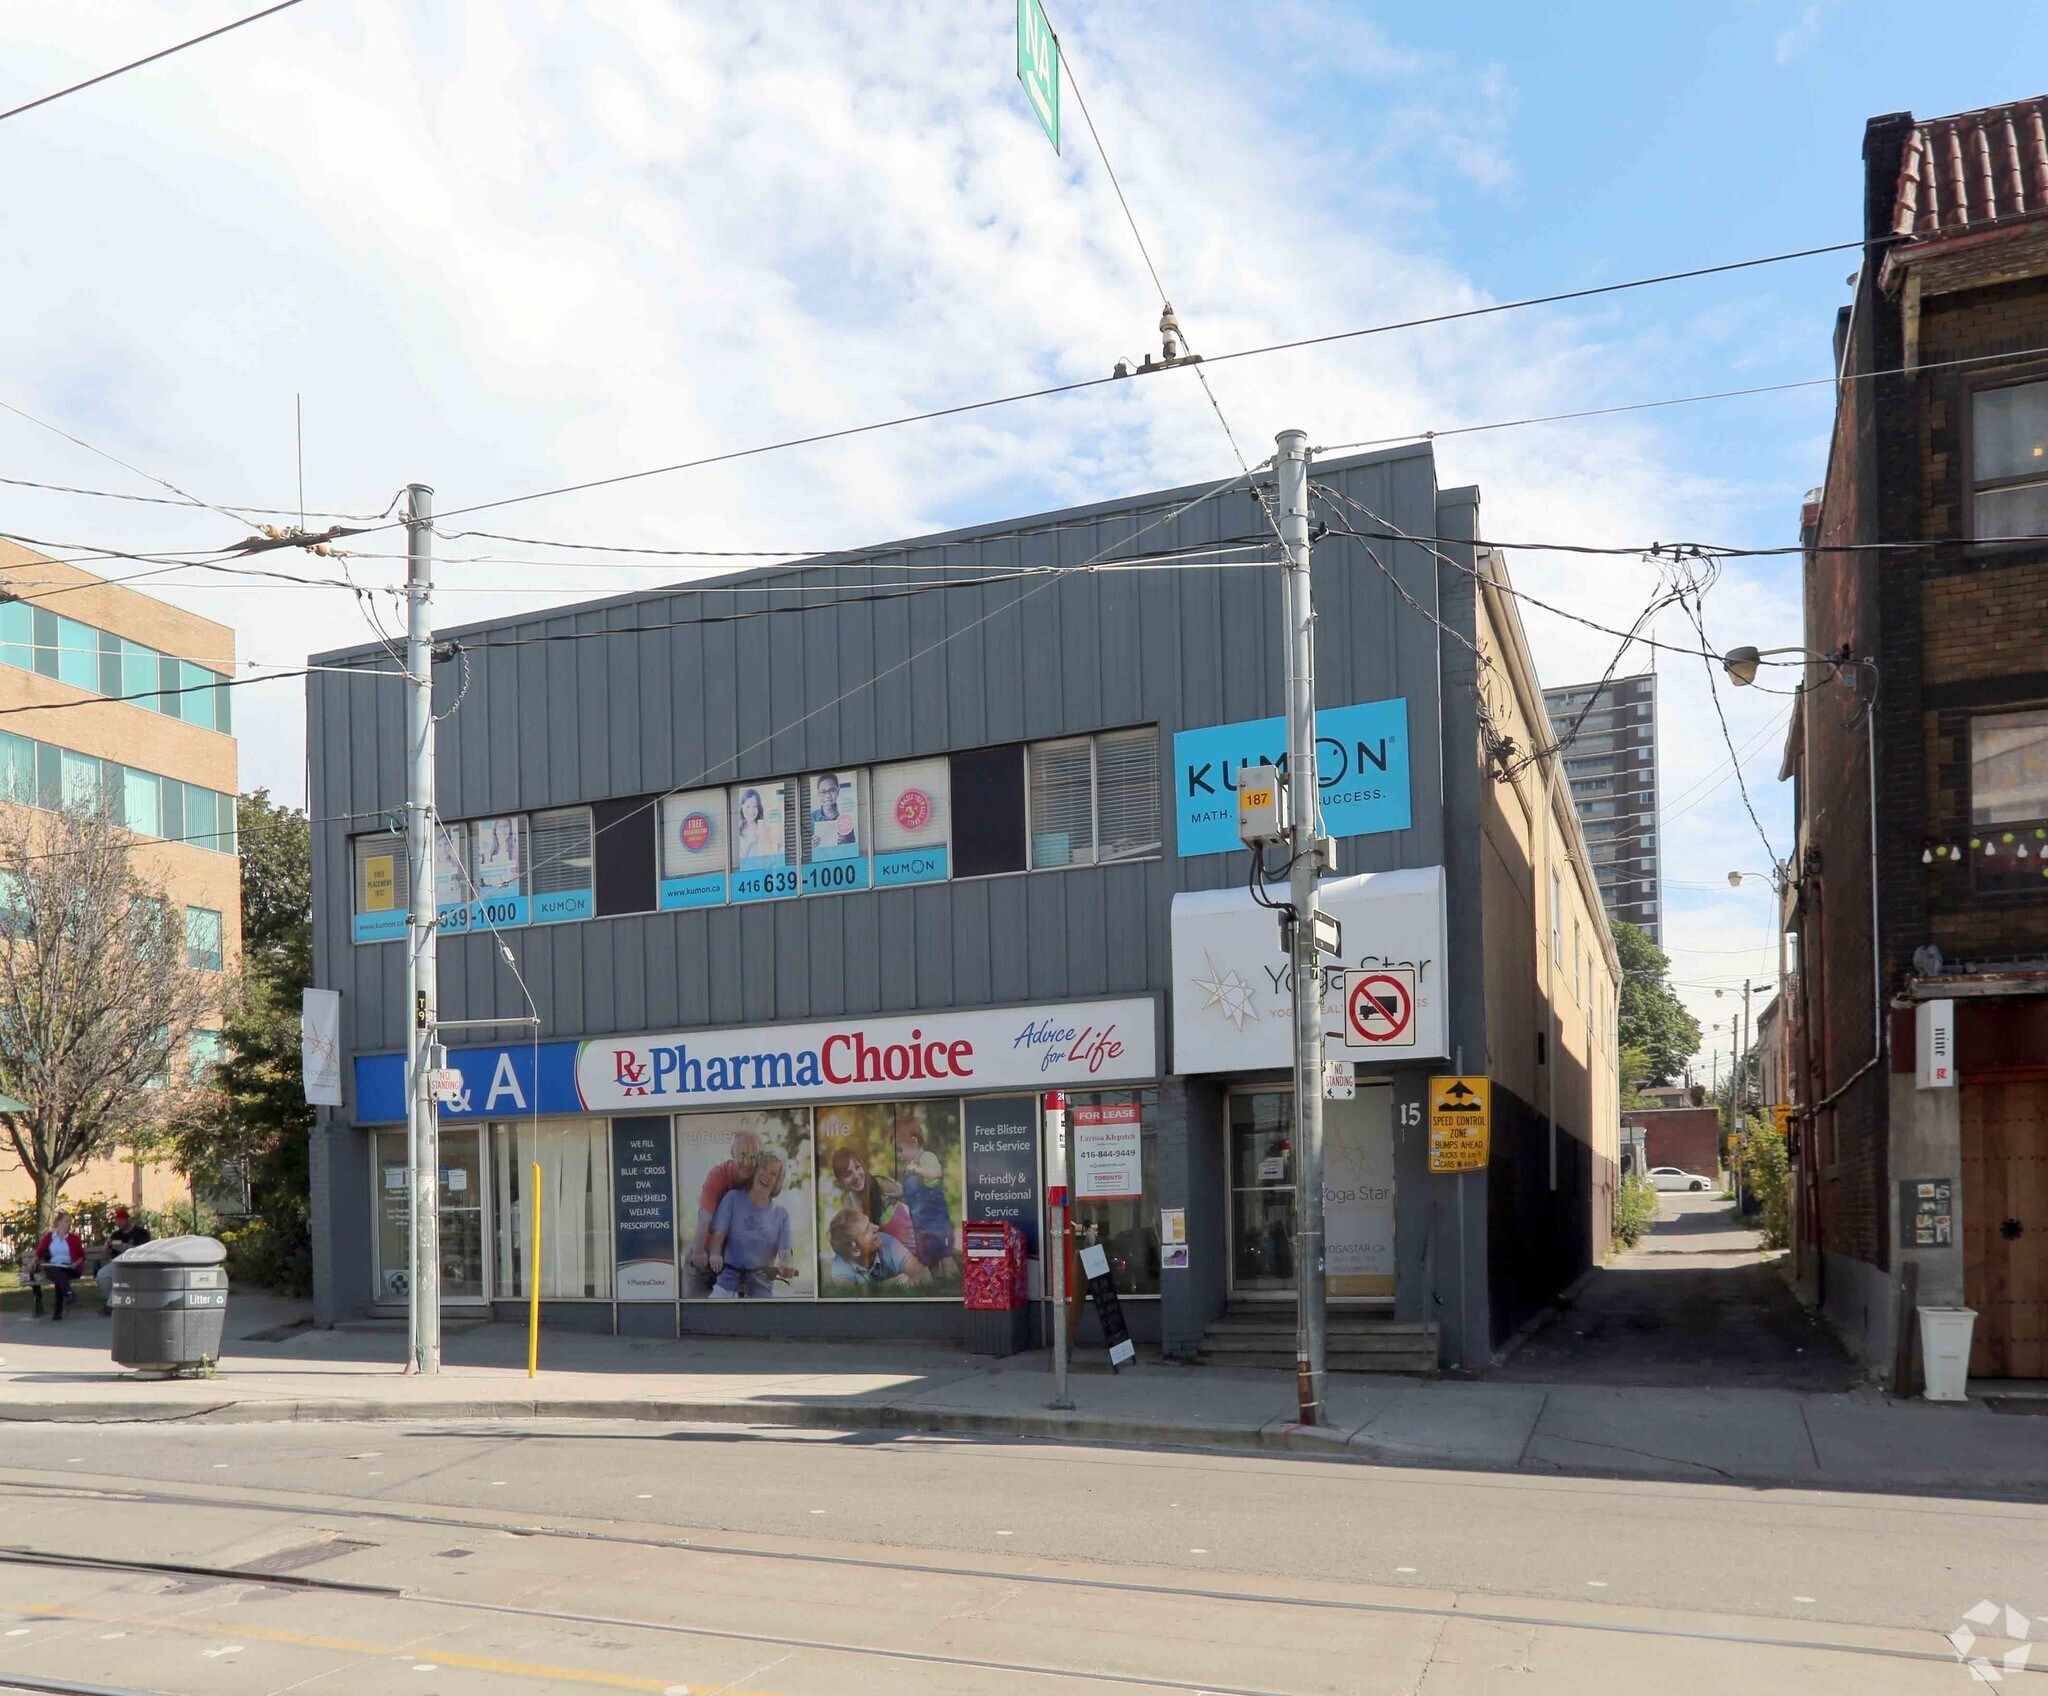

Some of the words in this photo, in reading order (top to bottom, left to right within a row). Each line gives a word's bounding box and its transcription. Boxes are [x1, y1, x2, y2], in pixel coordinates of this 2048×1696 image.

[1246, 793, 1268, 806] 187
[1318, 789, 1386, 806] UCCESS.
[1190, 810, 1233, 824] MATH.
[688, 818, 703, 829] FREE
[883, 859, 935, 875] KUMON
[374, 870, 385, 878] FREE
[738, 879, 761, 894] 416
[764, 865, 856, 893] 639-1000
[367, 880, 392, 888] PLACEMENT
[374, 889, 385, 897] TEST
[667, 884, 721, 898] www.kumon.ca
[541, 898, 585, 913] KUMON
[1013, 1018, 1076, 1049] Advice
[1041, 1045, 1066, 1072] for
[1067, 1024, 1125, 1073] Life
[648, 1028, 974, 1095] PharmaChoice
[1334, 1063, 1343, 1075] NO
[439, 1071, 451, 1080] NO
[1325, 1075, 1354, 1087] STANDING
[431, 1080, 459, 1090] STANDING
[485, 1053, 527, 1111] A
[1079, 1111, 1100, 1120] FOR
[1102, 1109, 1136, 1119] LEASE
[1400, 1102, 1421, 1126] 15
[1432, 1115, 1454, 1126] SPEED
[1456, 1115, 1486, 1126] CONTROL
[825, 1119, 850, 1137] life
[975, 1125, 995, 1136] Free
[997, 1124, 1027, 1136] Blister
[1450, 1129, 1468, 1139] ZONE
[630, 1140, 641, 1148] WE
[642, 1139, 655, 1148] FILL
[972, 1141, 995, 1152] Pack
[996, 1140, 1031, 1151] Service
[1435, 1141, 1458, 1150] BUMPS
[1461, 1140, 1484, 1149] AHEAD
[632, 1153, 653, 1162] A.M.S.
[1080, 1149, 1136, 1158] 416-844-9449
[620, 1167, 638, 1176] BLUE
[644, 1166, 666, 1175] CROSS
[636, 1180, 651, 1189] DVA
[979, 1173, 1016, 1187] Friendly
[1018, 1172, 1026, 1183] &
[621, 1195, 643, 1203] GREEN
[643, 1194, 667, 1202] SHIELD
[974, 1188, 1031, 1201] Professional
[1359, 1185, 1390, 1201] Star
[629, 1208, 660, 1217] WELFARE
[984, 1206, 1019, 1218] Service
[620, 1220, 670, 1230] PRESCRIPTIONS
[189, 1294, 211, 1305] Litter
